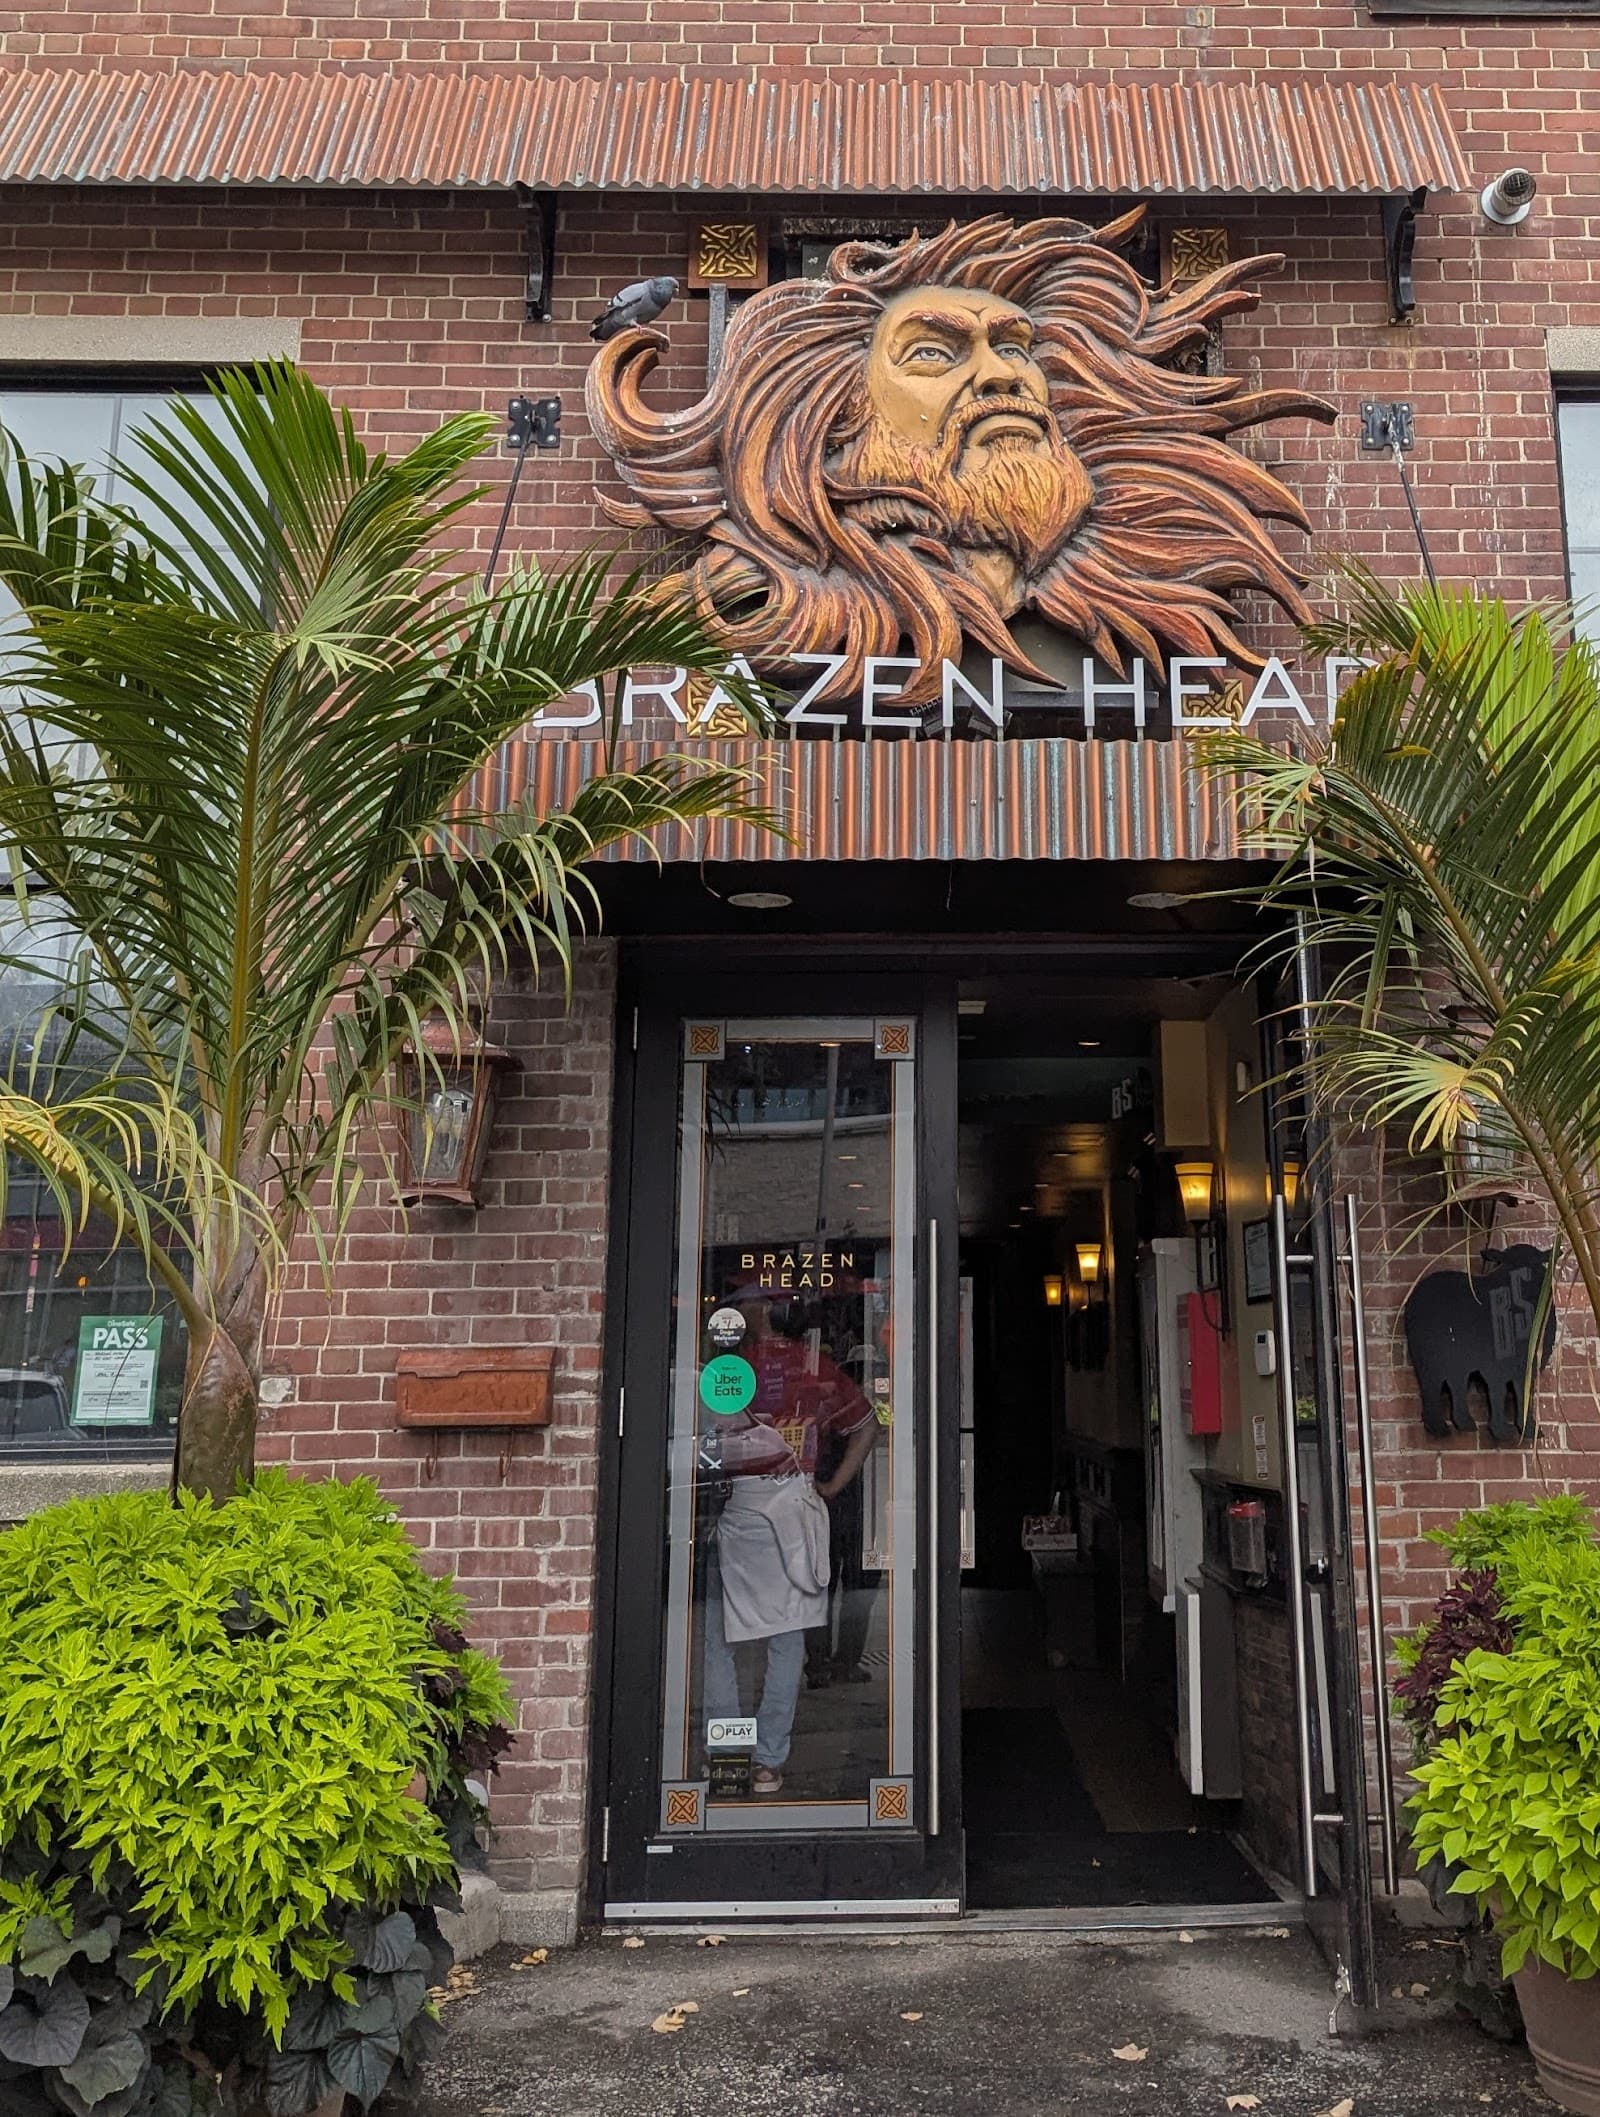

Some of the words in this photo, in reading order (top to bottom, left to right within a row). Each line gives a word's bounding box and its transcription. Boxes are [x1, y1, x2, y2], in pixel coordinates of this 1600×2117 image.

[741, 1253, 853, 1269] BRAZEN
[760, 1273, 834, 1288] HEAD
[92, 1327, 149, 1349] PASS
[714, 1374, 743, 1385] Uber
[714, 1385, 743, 1397] Eats
[725, 1727, 752, 1736] PLAY
